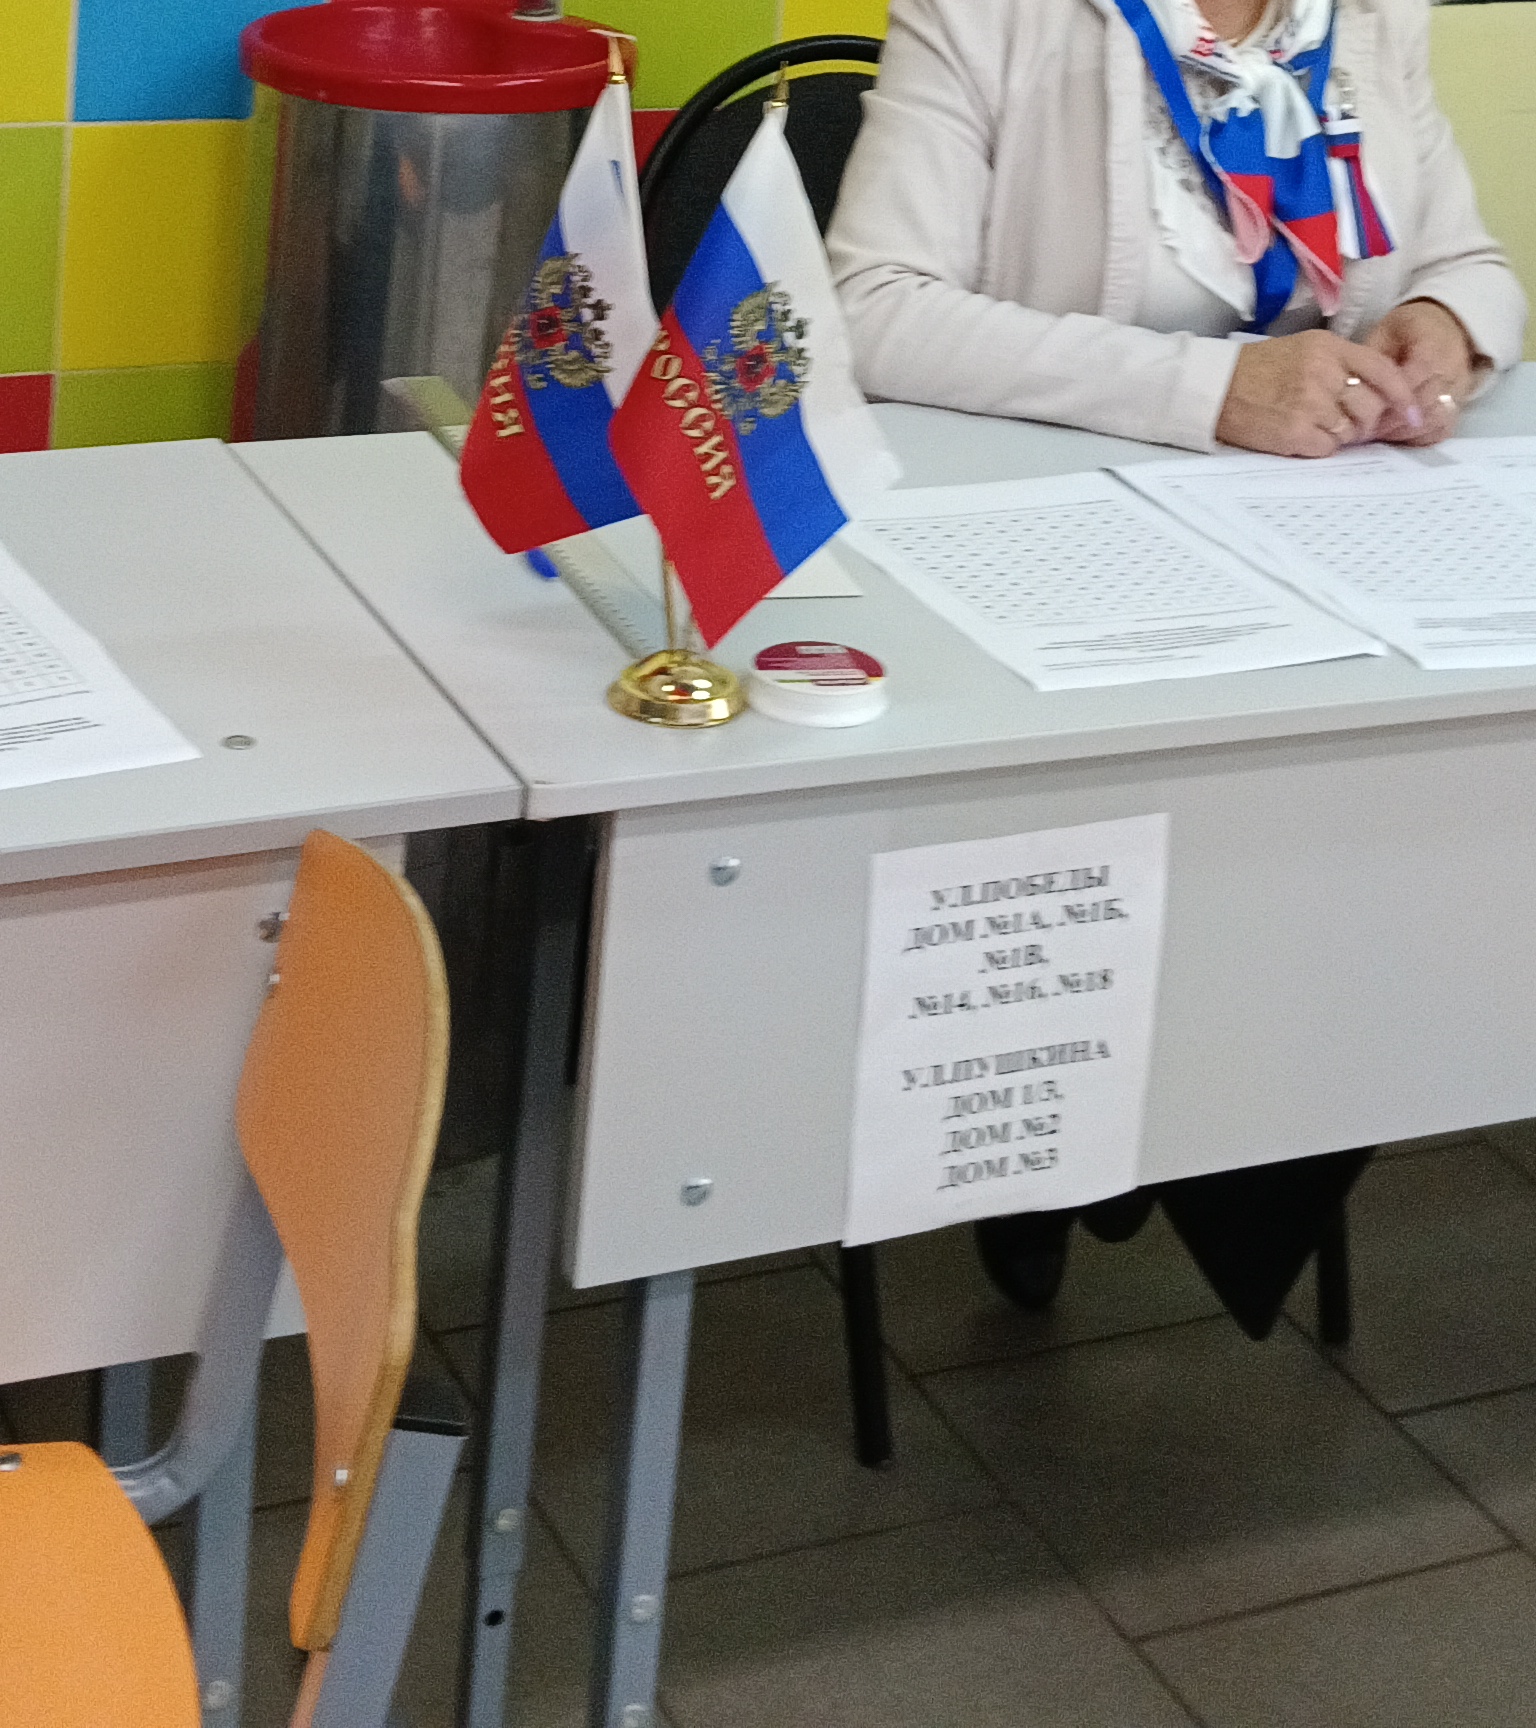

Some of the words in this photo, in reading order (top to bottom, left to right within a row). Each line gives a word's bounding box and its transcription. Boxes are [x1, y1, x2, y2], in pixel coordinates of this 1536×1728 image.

[902, 921, 975, 952] ДОМ
[941, 1087, 1013, 1120] ДОМ
[939, 1122, 1012, 1155] ДОМ
[936, 1156, 1009, 1190] ДОМ
